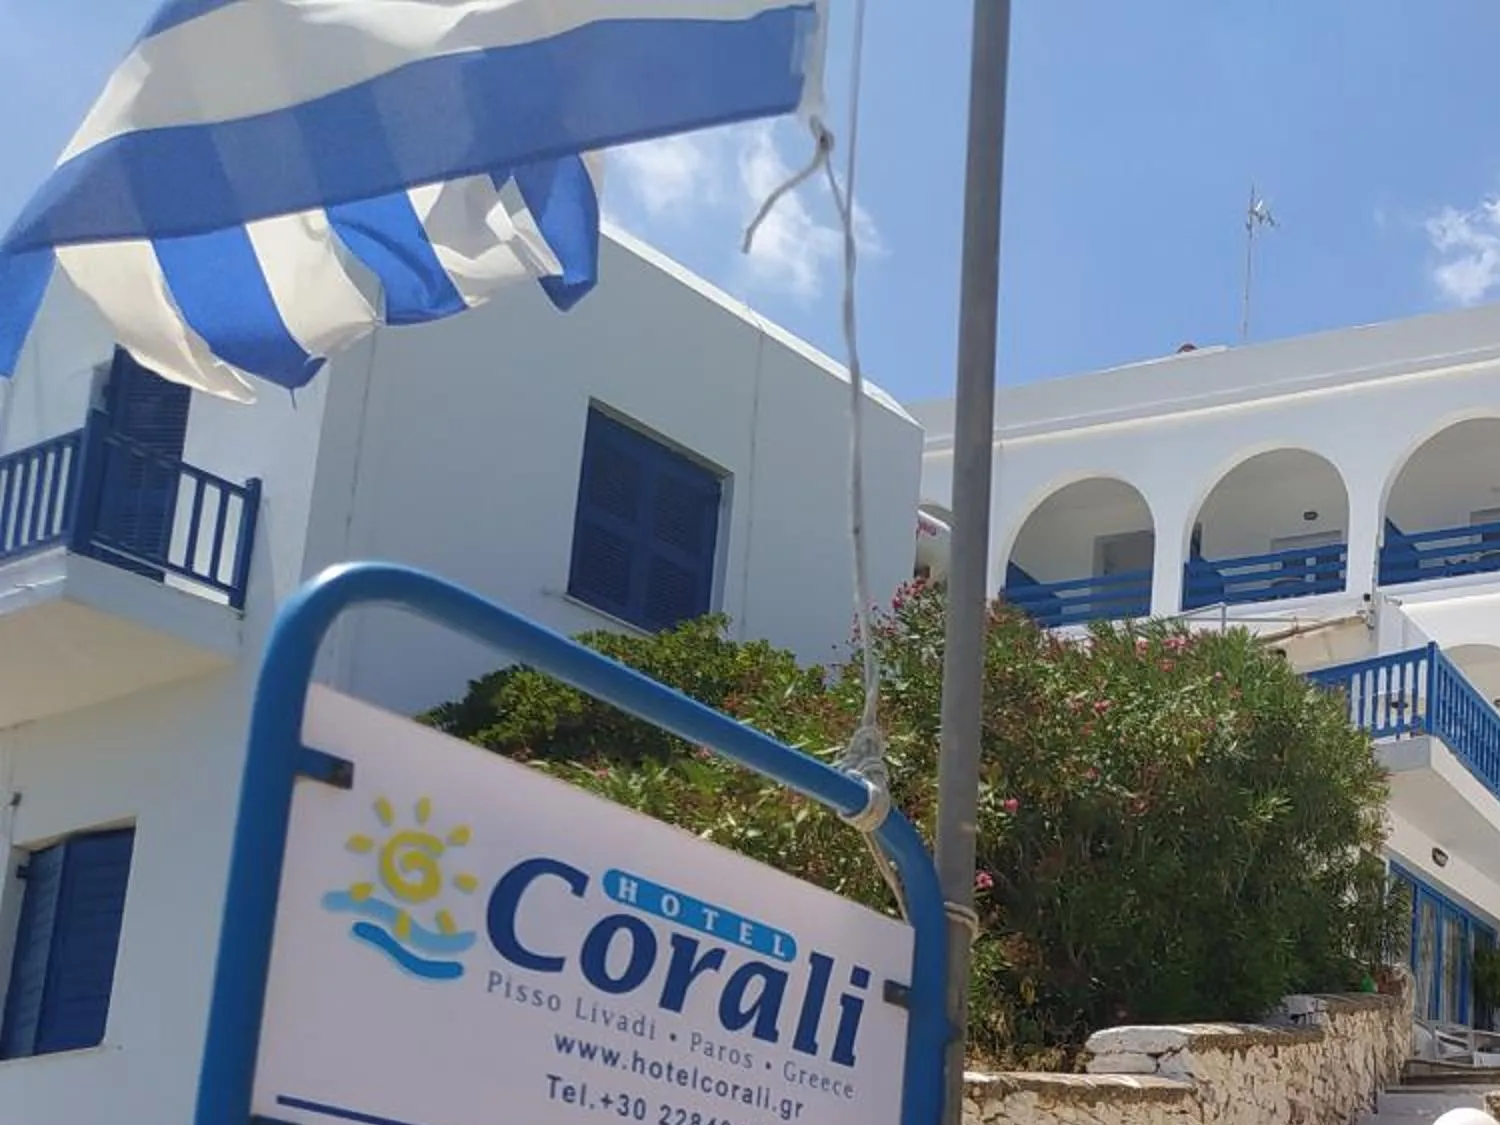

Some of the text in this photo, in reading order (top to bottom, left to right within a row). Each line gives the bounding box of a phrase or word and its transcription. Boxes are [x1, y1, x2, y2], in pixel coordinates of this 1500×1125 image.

[617, 874, 787, 959] HOTEL
[486, 857, 871, 1067] Corali
[487, 971, 855, 1100] Pisso Livadi Paros Greece
[554, 1033, 804, 1121] www.hotelcorali.gr
[546, 1073, 646, 1121] Tel.+30
